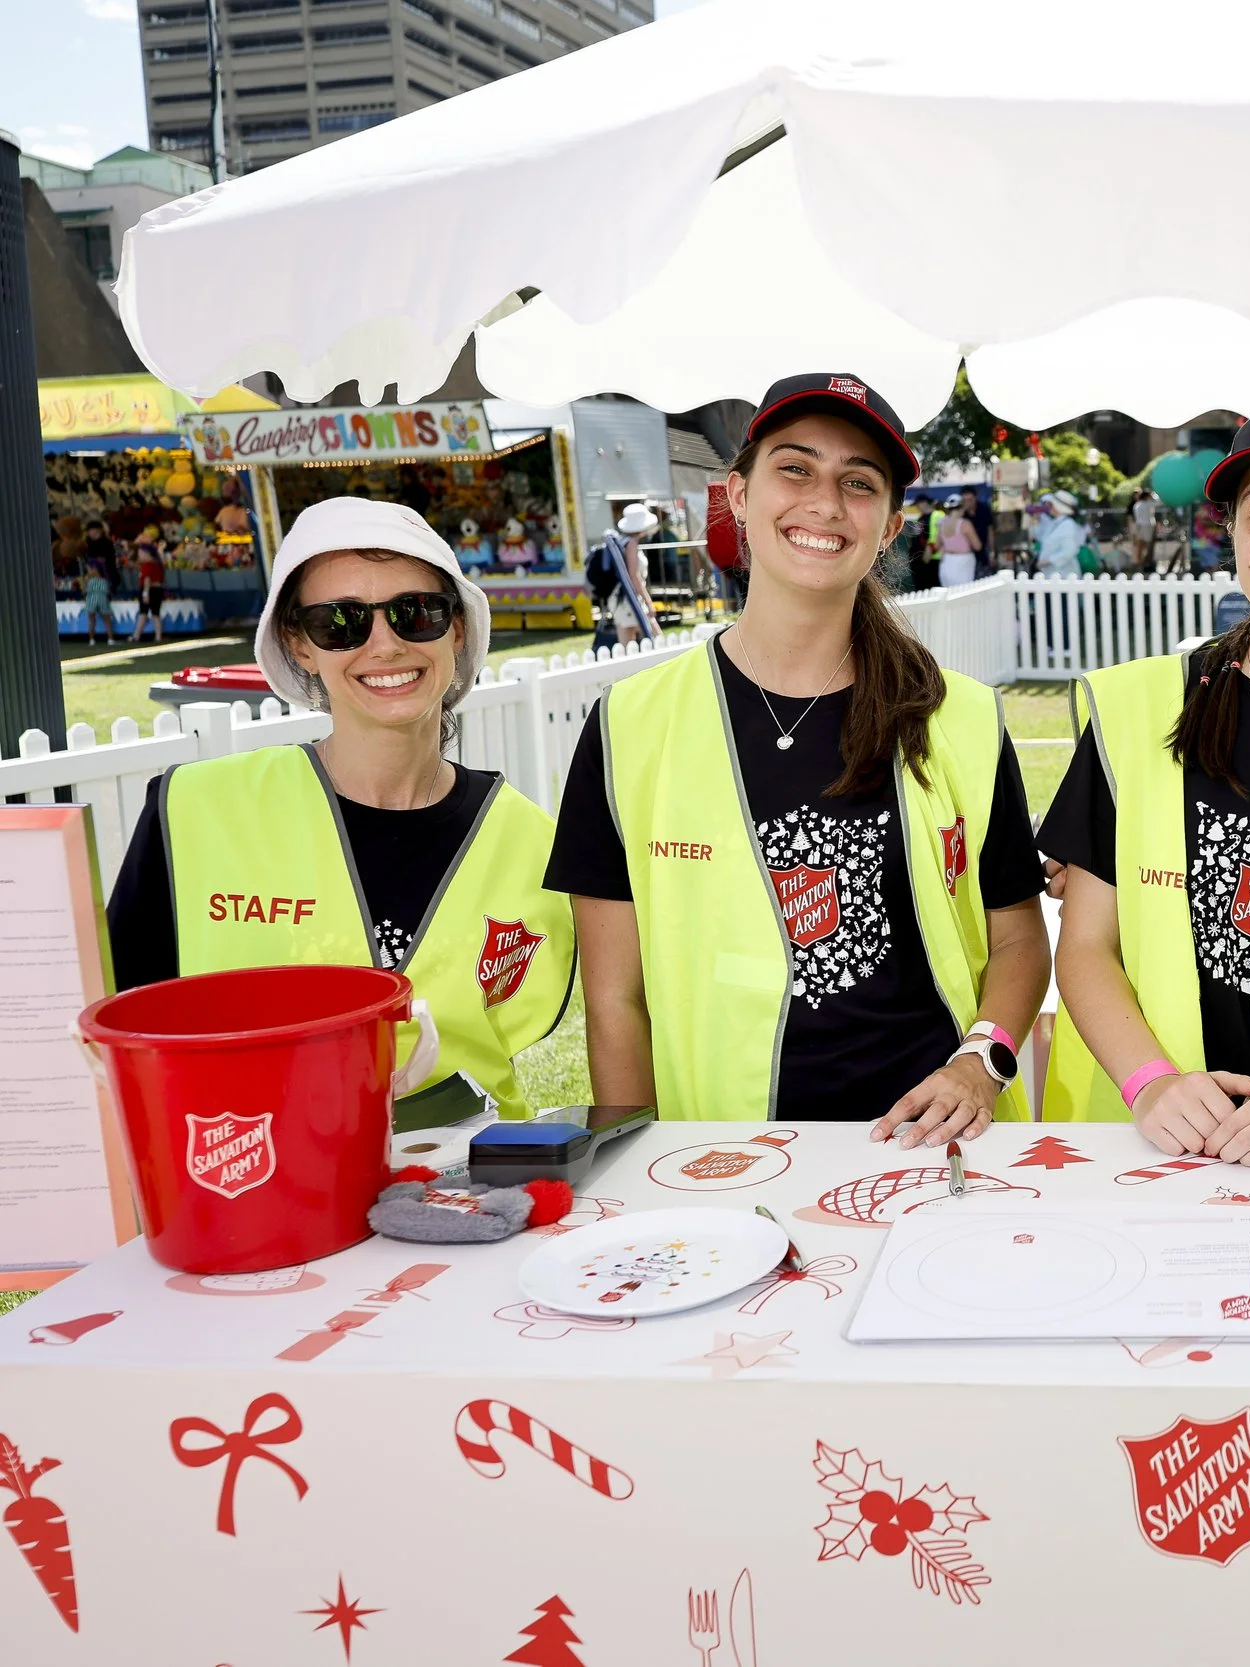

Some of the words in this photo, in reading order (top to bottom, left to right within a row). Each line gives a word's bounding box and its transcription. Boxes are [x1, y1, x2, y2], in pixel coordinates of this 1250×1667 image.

[233, 416, 330, 459] Laughing
[318, 410, 439, 451] CLOWNS
[779, 870, 808, 899] THE
[782, 874, 833, 921] ALVATION
[208, 893, 317, 925] STAFF
[793, 898, 832, 939] ARMY
[496, 927, 523, 952] THE
[193, 1122, 265, 1176] SALVATION
[202, 1120, 236, 1149] THE
[219, 1145, 263, 1187] ARMY
[681, 1157, 759, 1171] SALVATION
[693, 1165, 745, 1177] ARMY
[707, 1153, 740, 1162] THE
[1225, 1296, 1250, 1310] ARMY
[1149, 1426, 1200, 1487] THE
